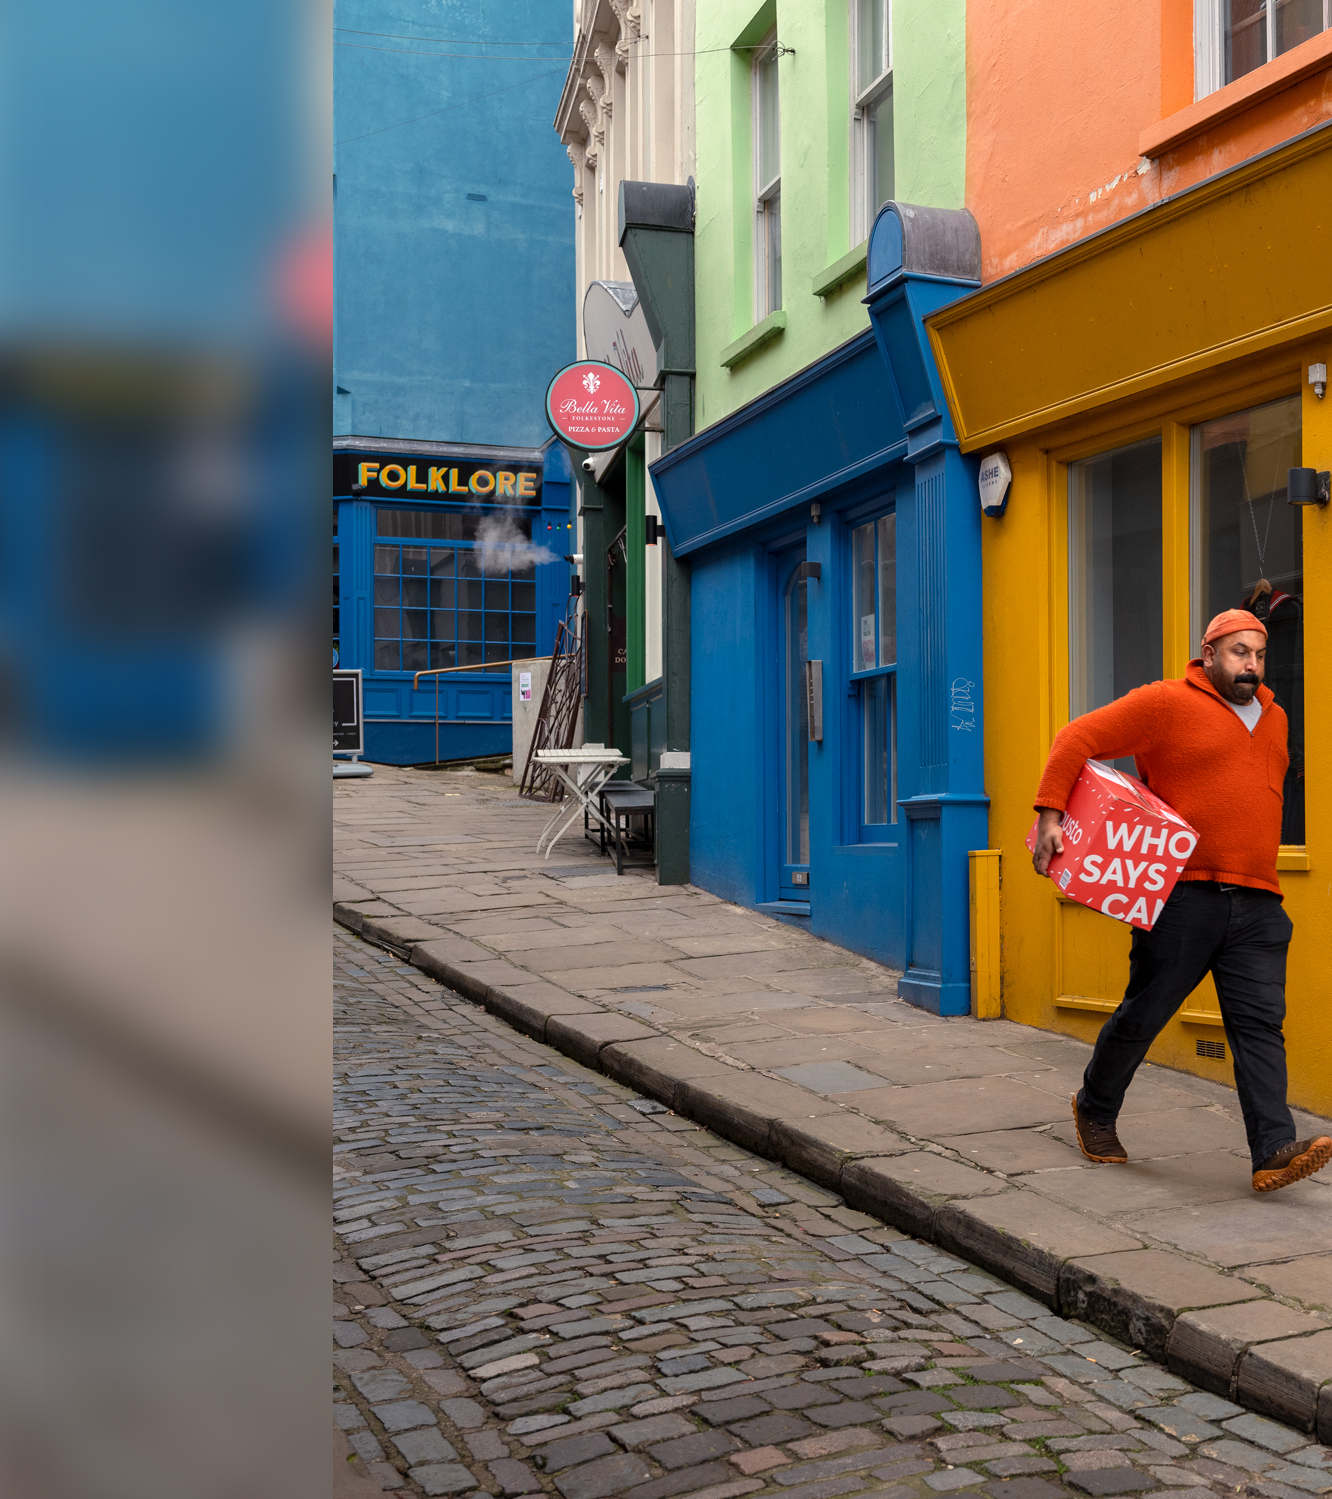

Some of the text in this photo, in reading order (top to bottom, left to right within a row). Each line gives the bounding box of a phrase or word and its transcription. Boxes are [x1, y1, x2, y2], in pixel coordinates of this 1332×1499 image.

[560, 399, 627, 415] Bella Vita
[358, 462, 537, 498] FOLKLORE
[980, 466, 999, 483] ASHE
[1105, 820, 1198, 859] WHO
[1078, 854, 1168, 891] SAYS
